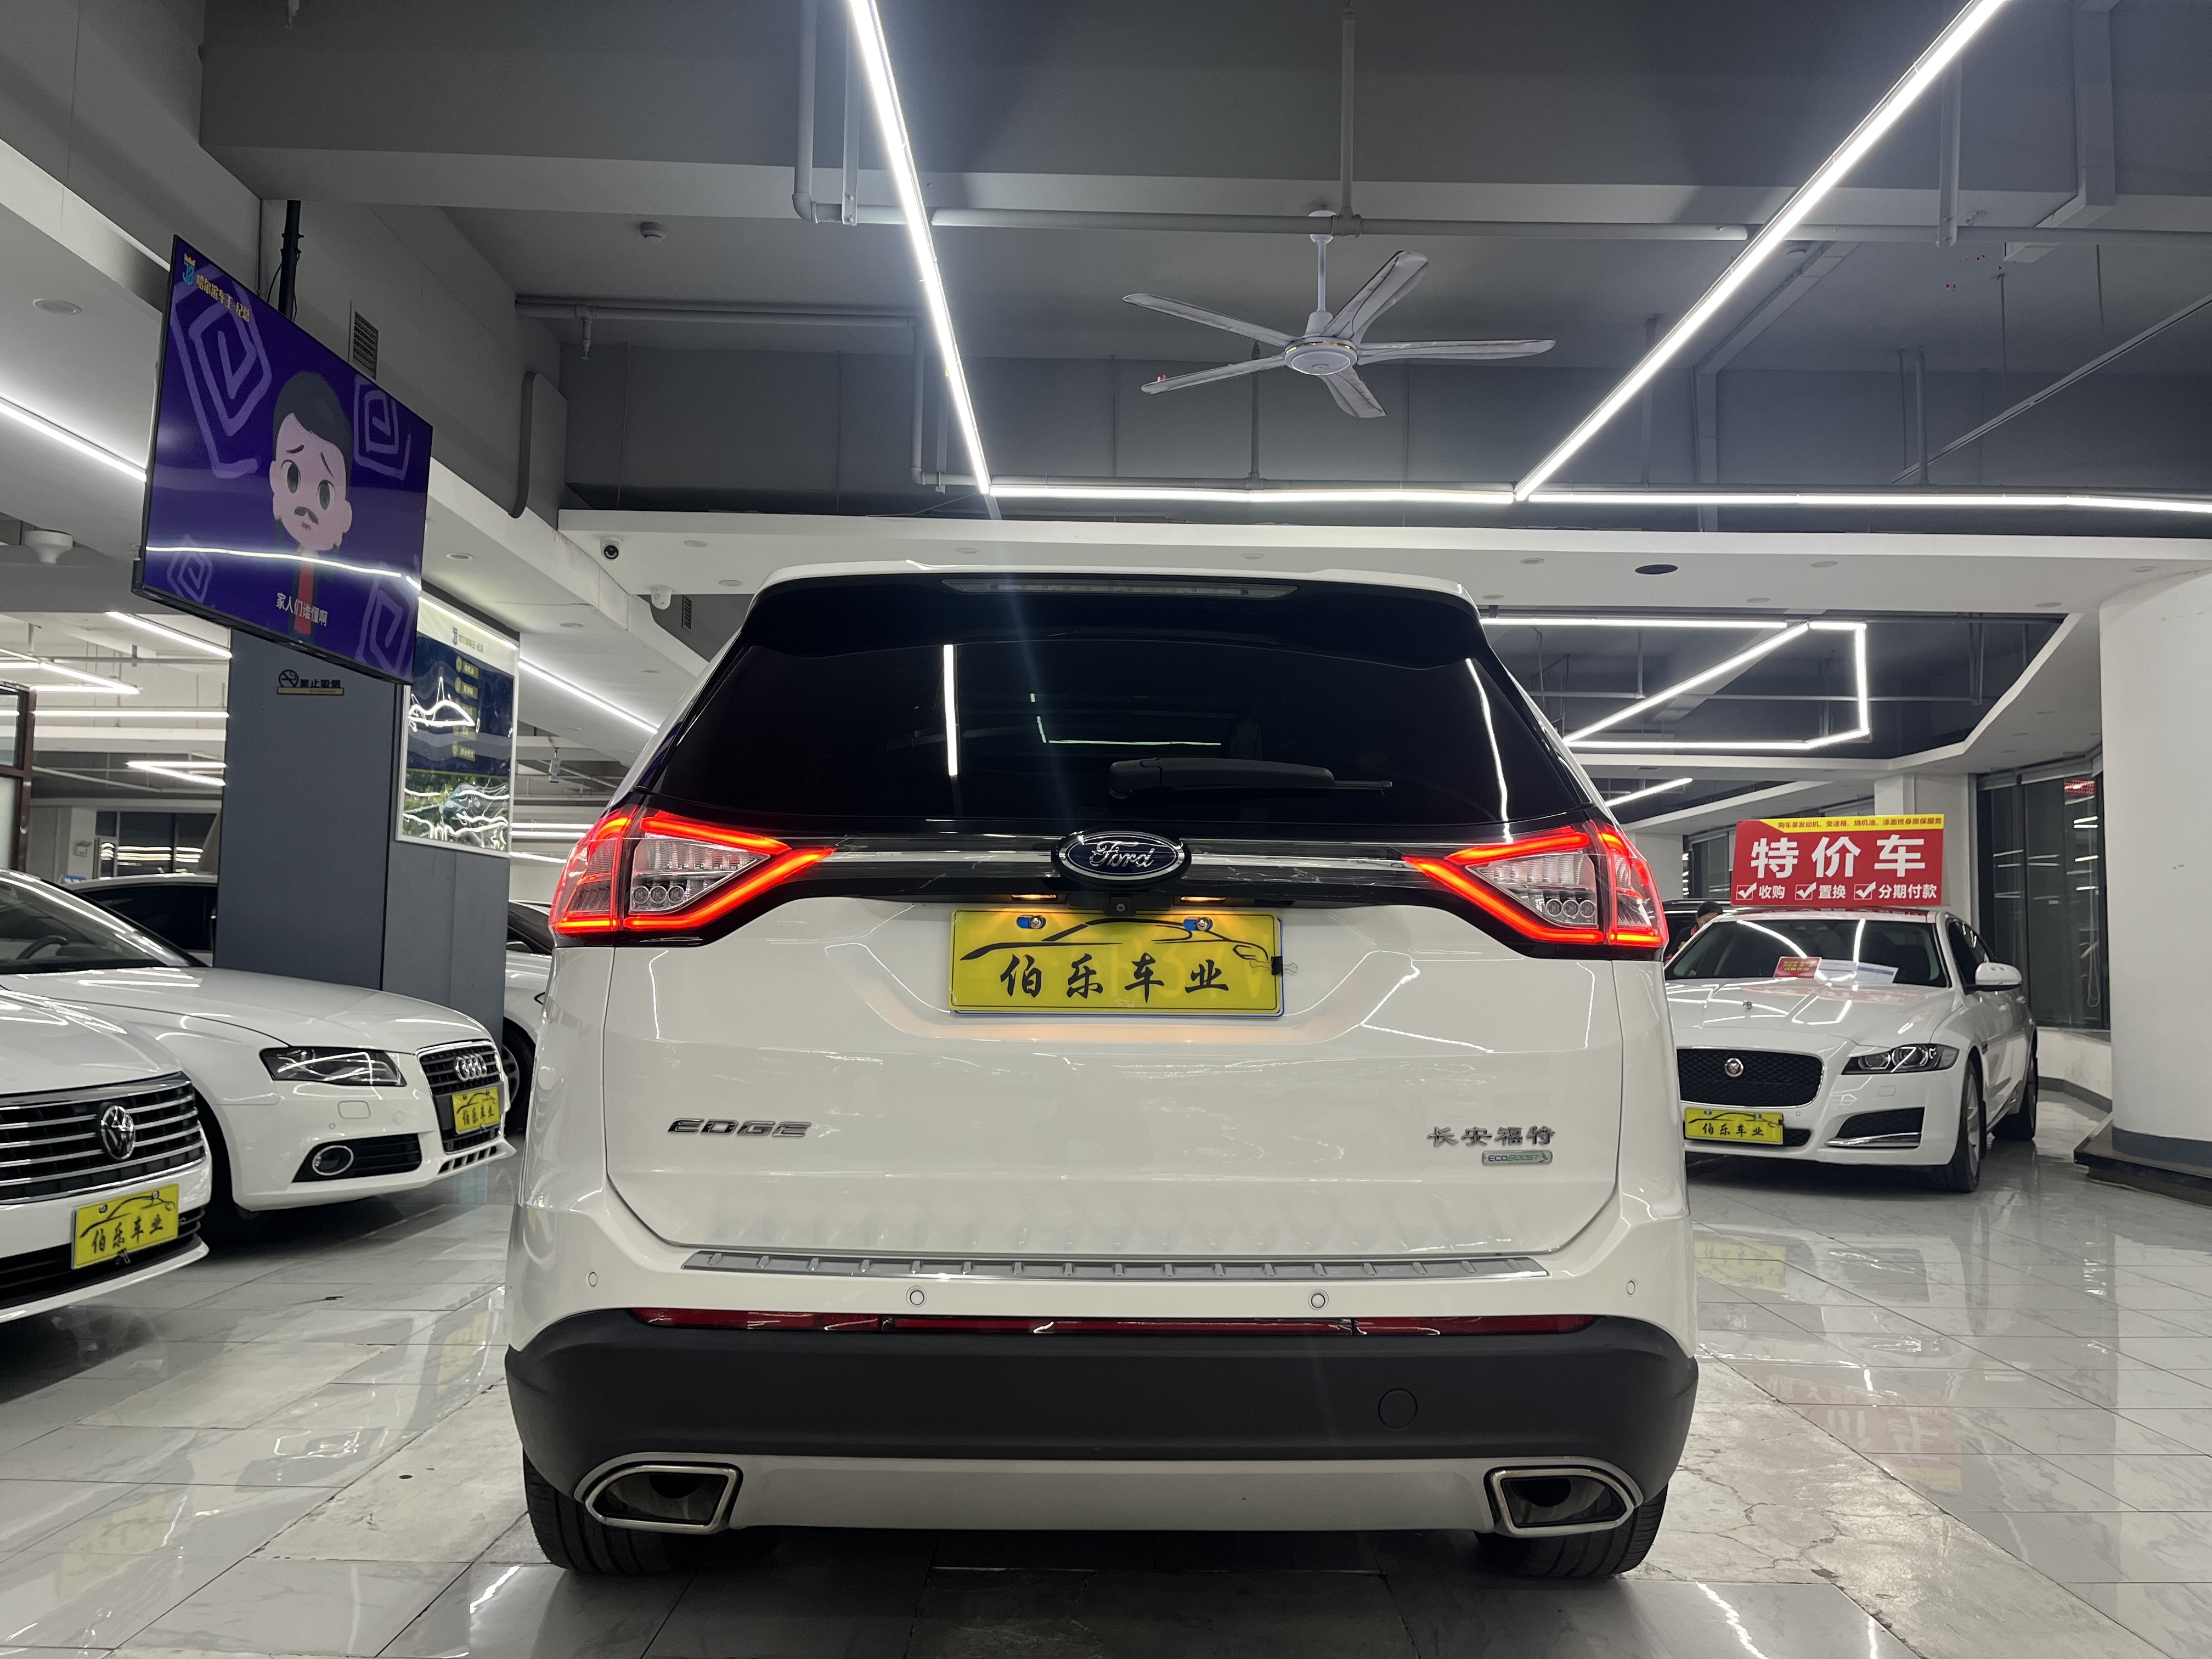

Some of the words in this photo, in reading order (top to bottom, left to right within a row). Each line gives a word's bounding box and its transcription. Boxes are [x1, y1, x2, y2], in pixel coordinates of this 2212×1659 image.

[276, 592, 328, 627] 家人们谁懂啊
[1090, 840, 1155, 868] Ford
[1751, 834, 1926, 878] 特价车
[1758, 884, 1785, 900] 收购
[1818, 884, 1847, 900] 置换
[1878, 884, 1937, 900] 分期付款
[1000, 952, 1229, 1003] 伯乐车业
[667, 1118, 812, 1137] EDGE
[1427, 1125, 1556, 1147] 长安福特
[1702, 1123, 1764, 1138] 伯乐车业
[92, 1214, 163, 1254] 伯乐车业
